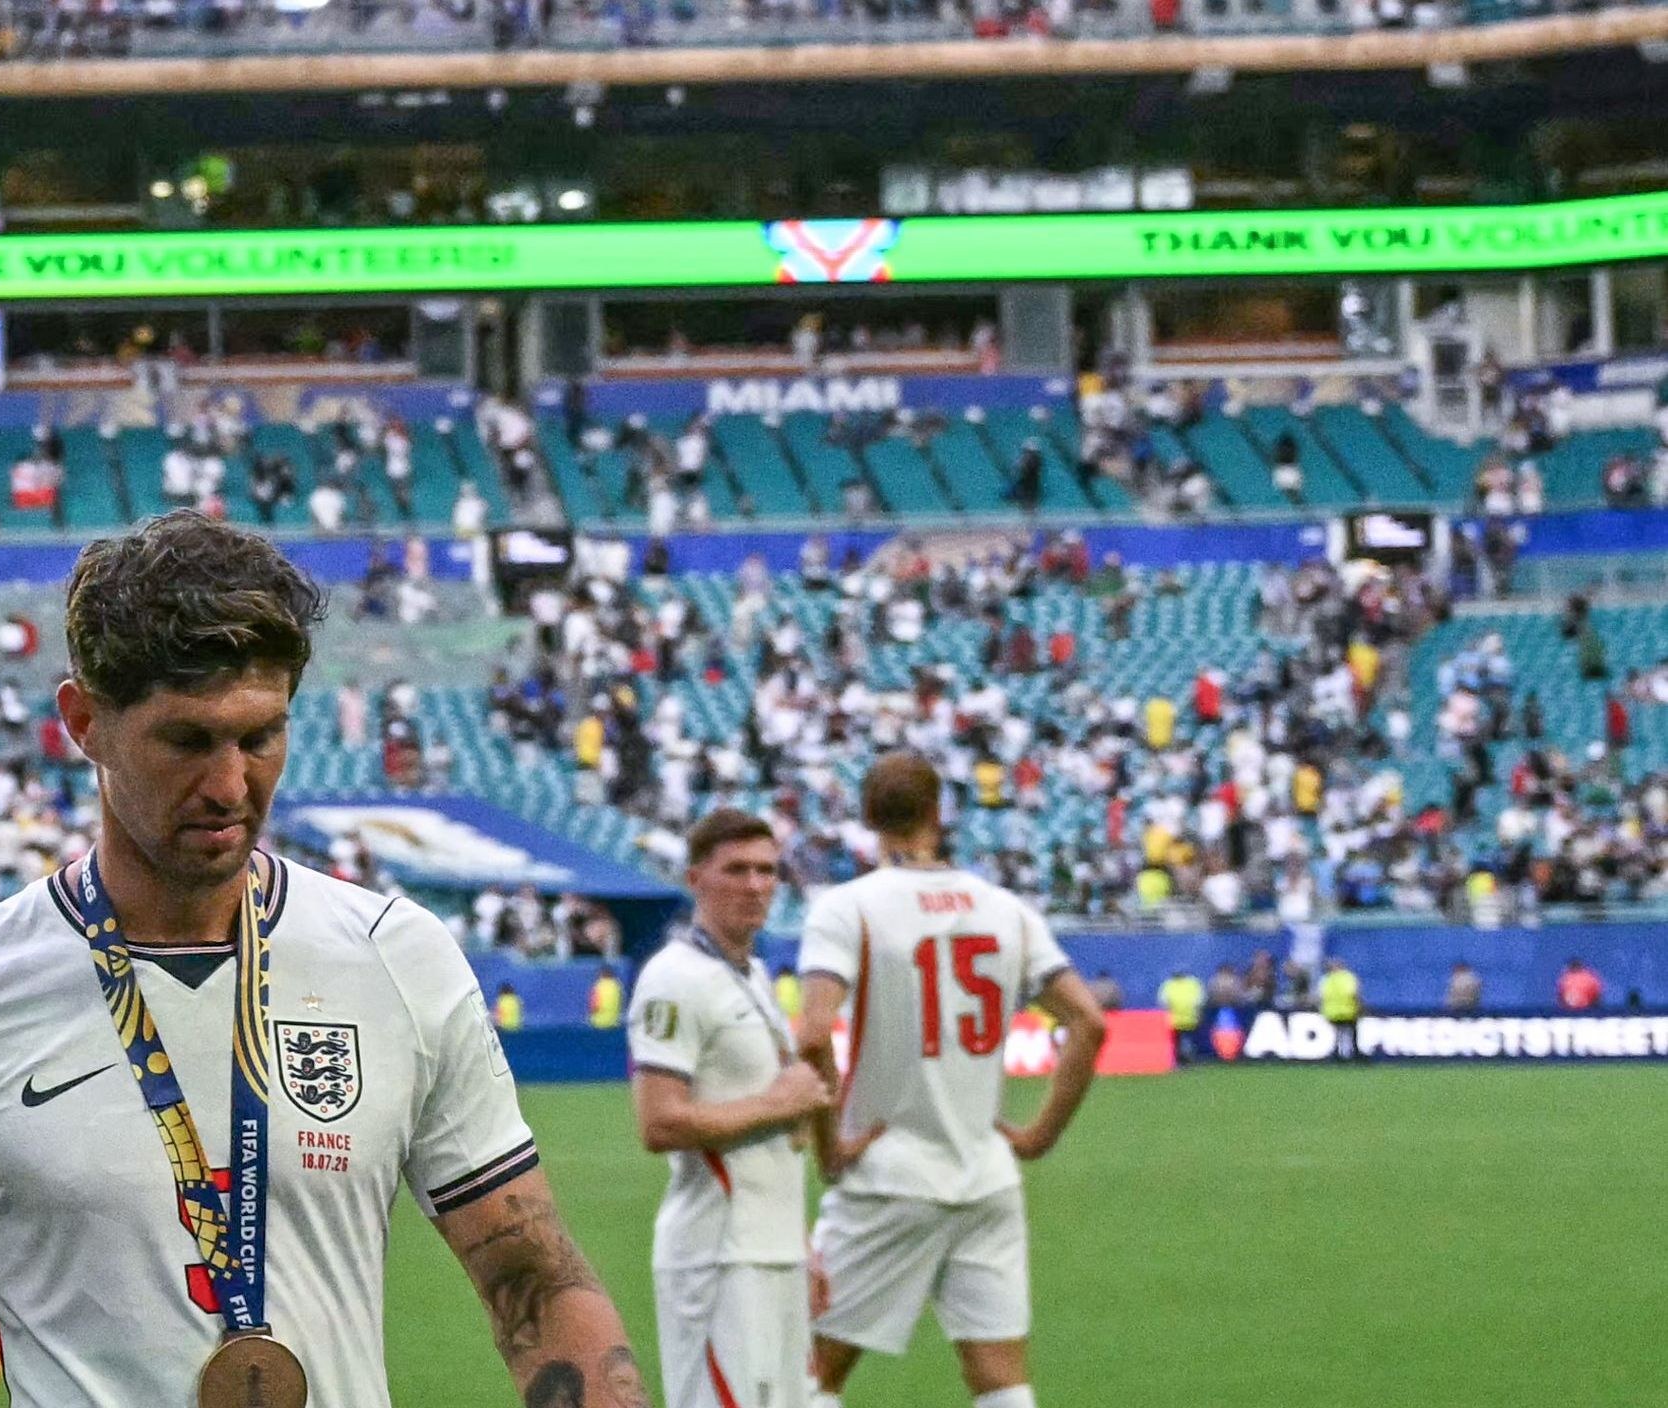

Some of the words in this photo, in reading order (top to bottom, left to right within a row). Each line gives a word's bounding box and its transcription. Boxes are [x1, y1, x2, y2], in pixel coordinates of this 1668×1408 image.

[1140, 230, 1309, 250] THANK
[708, 377, 900, 413] MIAMI
[915, 934, 1003, 1060] 15
[241, 1119, 257, 1163] FIFA
[298, 1131, 352, 1151] FRANCE
[302, 1153, 349, 1173] 18.07.26
[240, 1167, 257, 1241] WORLD
[229, 1294, 254, 1330] FIF
